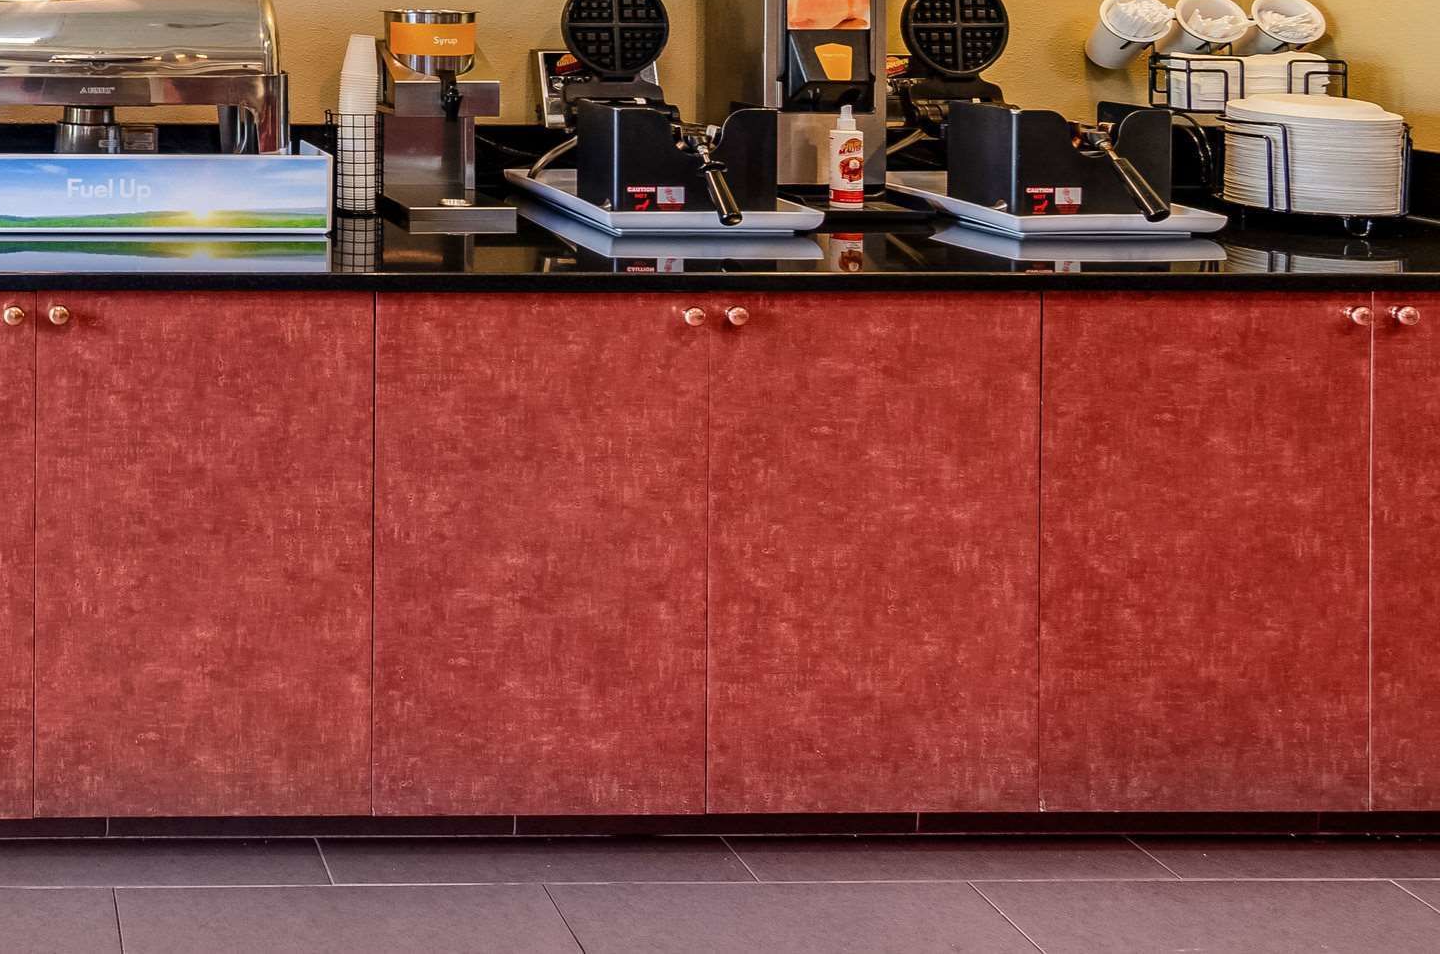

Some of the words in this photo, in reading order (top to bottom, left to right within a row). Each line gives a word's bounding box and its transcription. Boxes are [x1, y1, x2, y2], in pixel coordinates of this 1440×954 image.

[432, 36, 458, 46] Syrup
[66, 178, 114, 199] Fuel
[119, 178, 151, 204] Up
